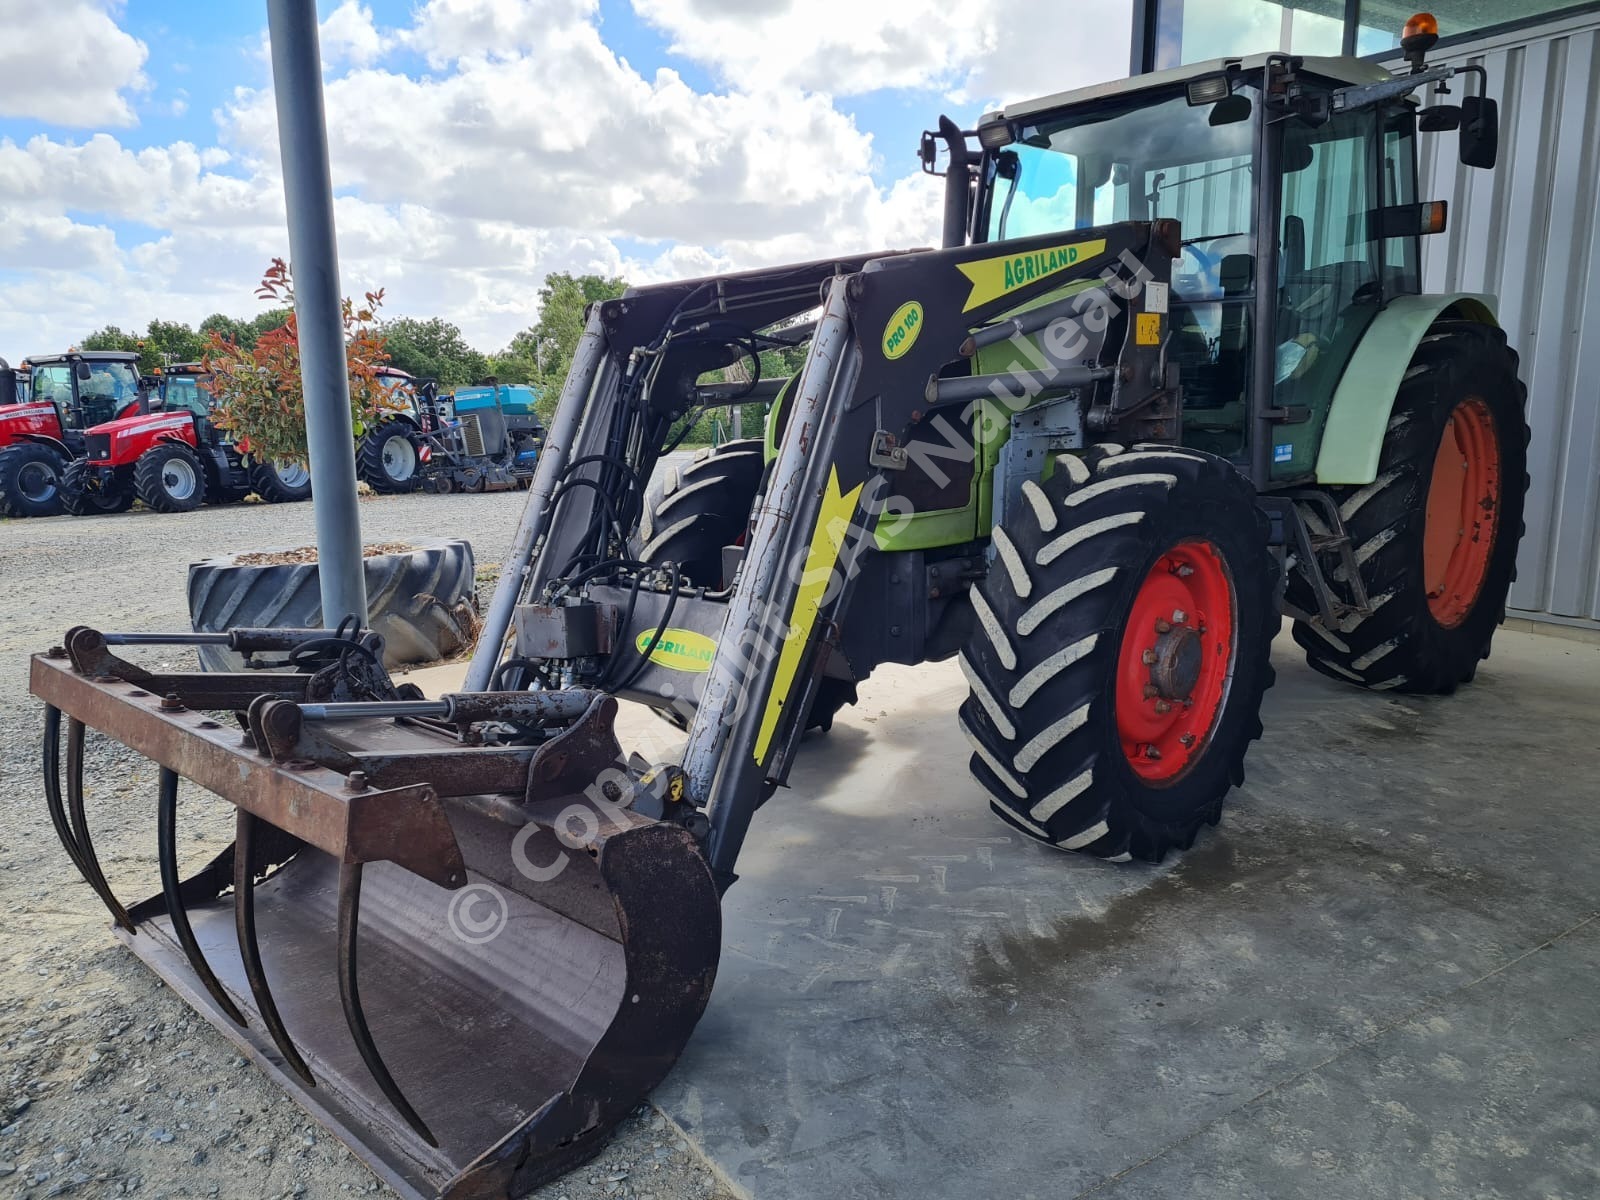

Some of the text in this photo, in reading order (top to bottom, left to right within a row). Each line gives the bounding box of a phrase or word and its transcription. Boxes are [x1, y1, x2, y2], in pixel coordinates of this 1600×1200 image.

[1004, 247, 1078, 289] AGRILAND
[887, 308, 918, 352] PRO 100
[641, 637, 712, 662] AGRILAN
